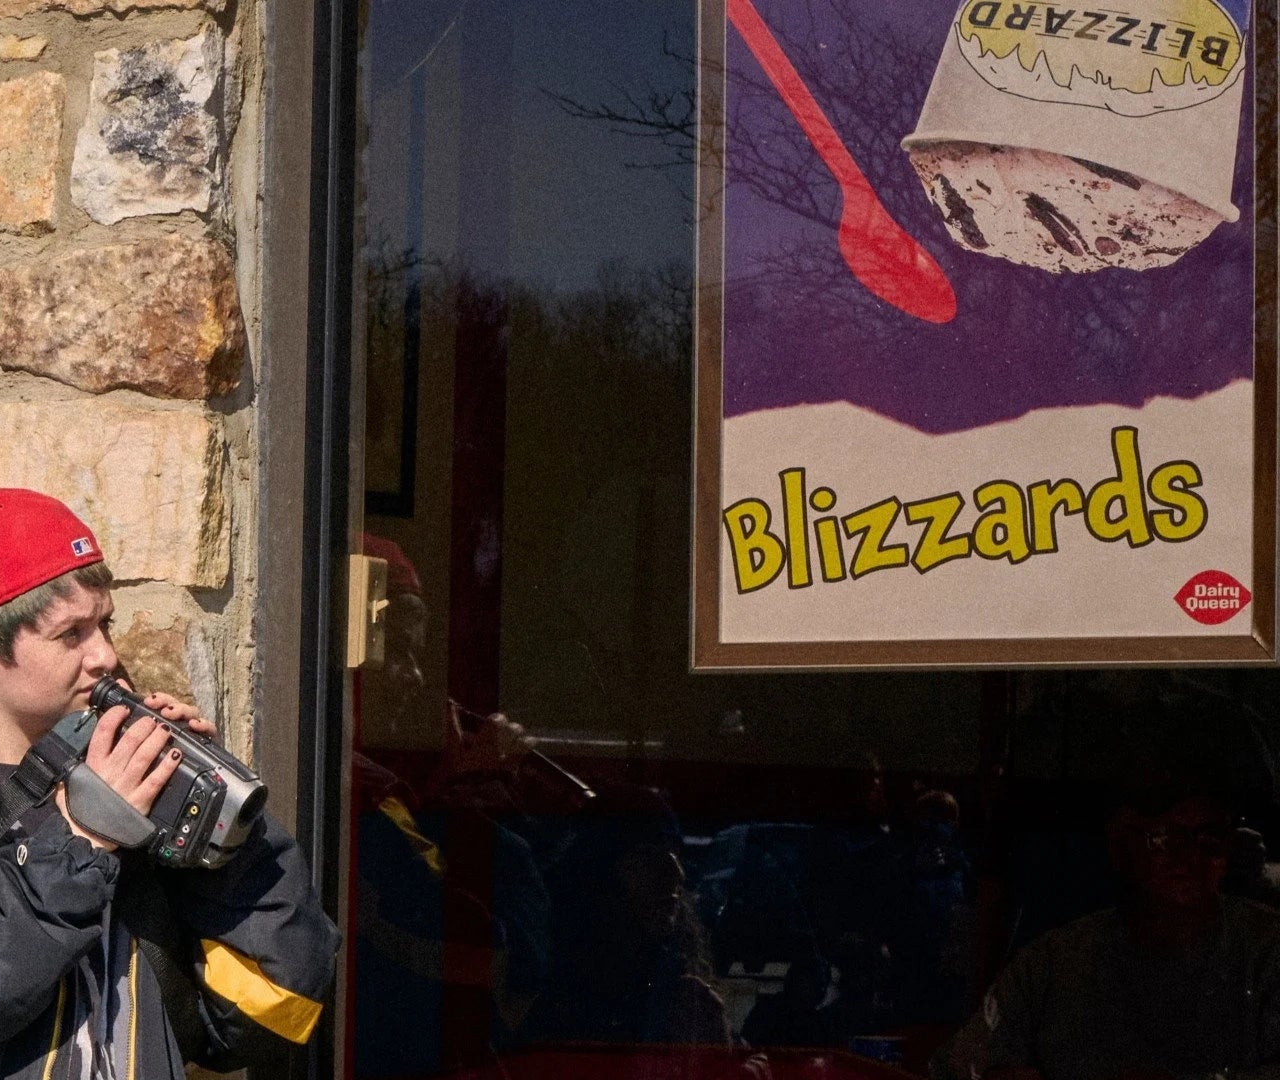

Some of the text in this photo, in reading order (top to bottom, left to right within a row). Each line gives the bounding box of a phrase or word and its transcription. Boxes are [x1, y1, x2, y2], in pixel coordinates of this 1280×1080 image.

[968, 1, 1230, 67] BLIZZARD
[722, 425, 1209, 595] Blizzards
[1185, 596, 1240, 612] Queen
[1194, 582, 1240, 599] Dairy
